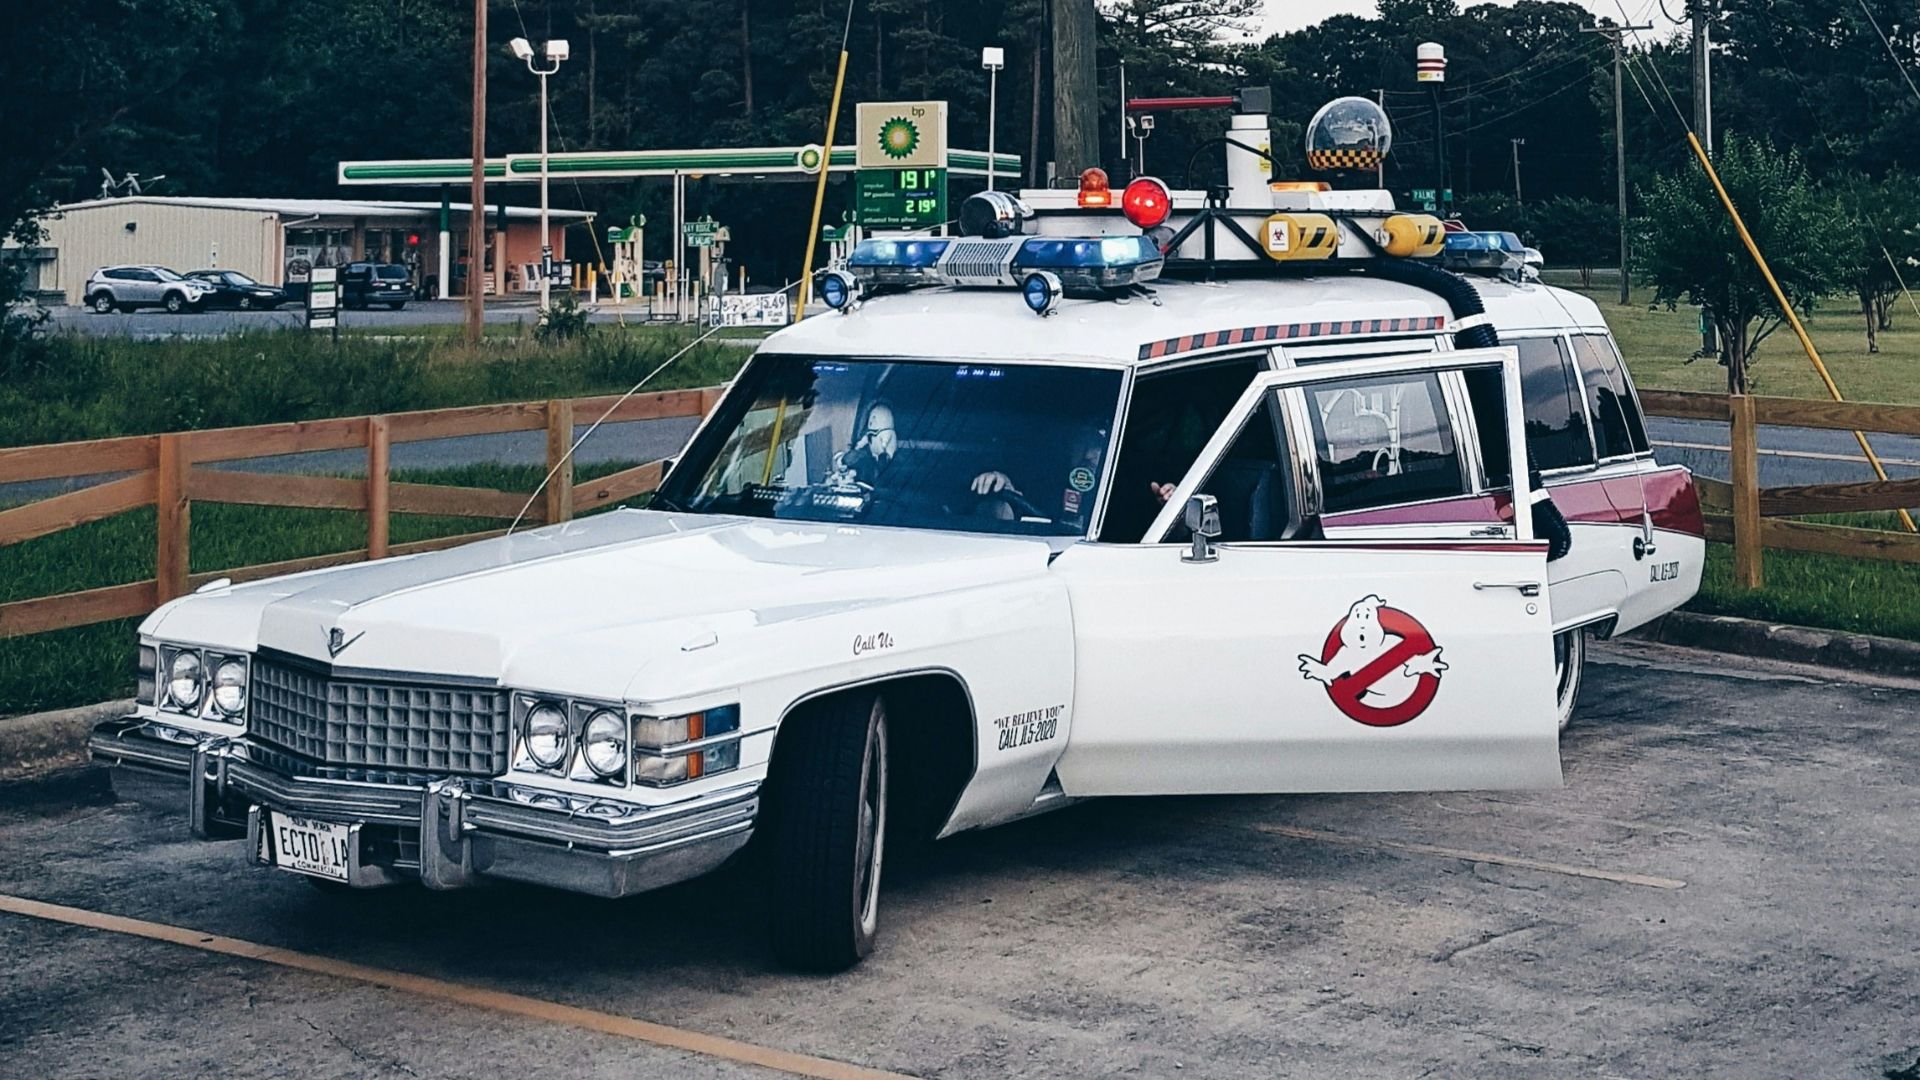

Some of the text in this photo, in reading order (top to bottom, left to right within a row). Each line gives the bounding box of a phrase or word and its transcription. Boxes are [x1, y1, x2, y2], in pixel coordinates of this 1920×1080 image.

[911, 106, 925, 117] bp
[853, 631, 894, 656] Call Us
[1012, 709, 1043, 726] BELIEVE
[998, 727, 1018, 751] CALL
[280, 826, 319, 863] ECTO
[297, 860, 338, 876] COMMERCIAL
